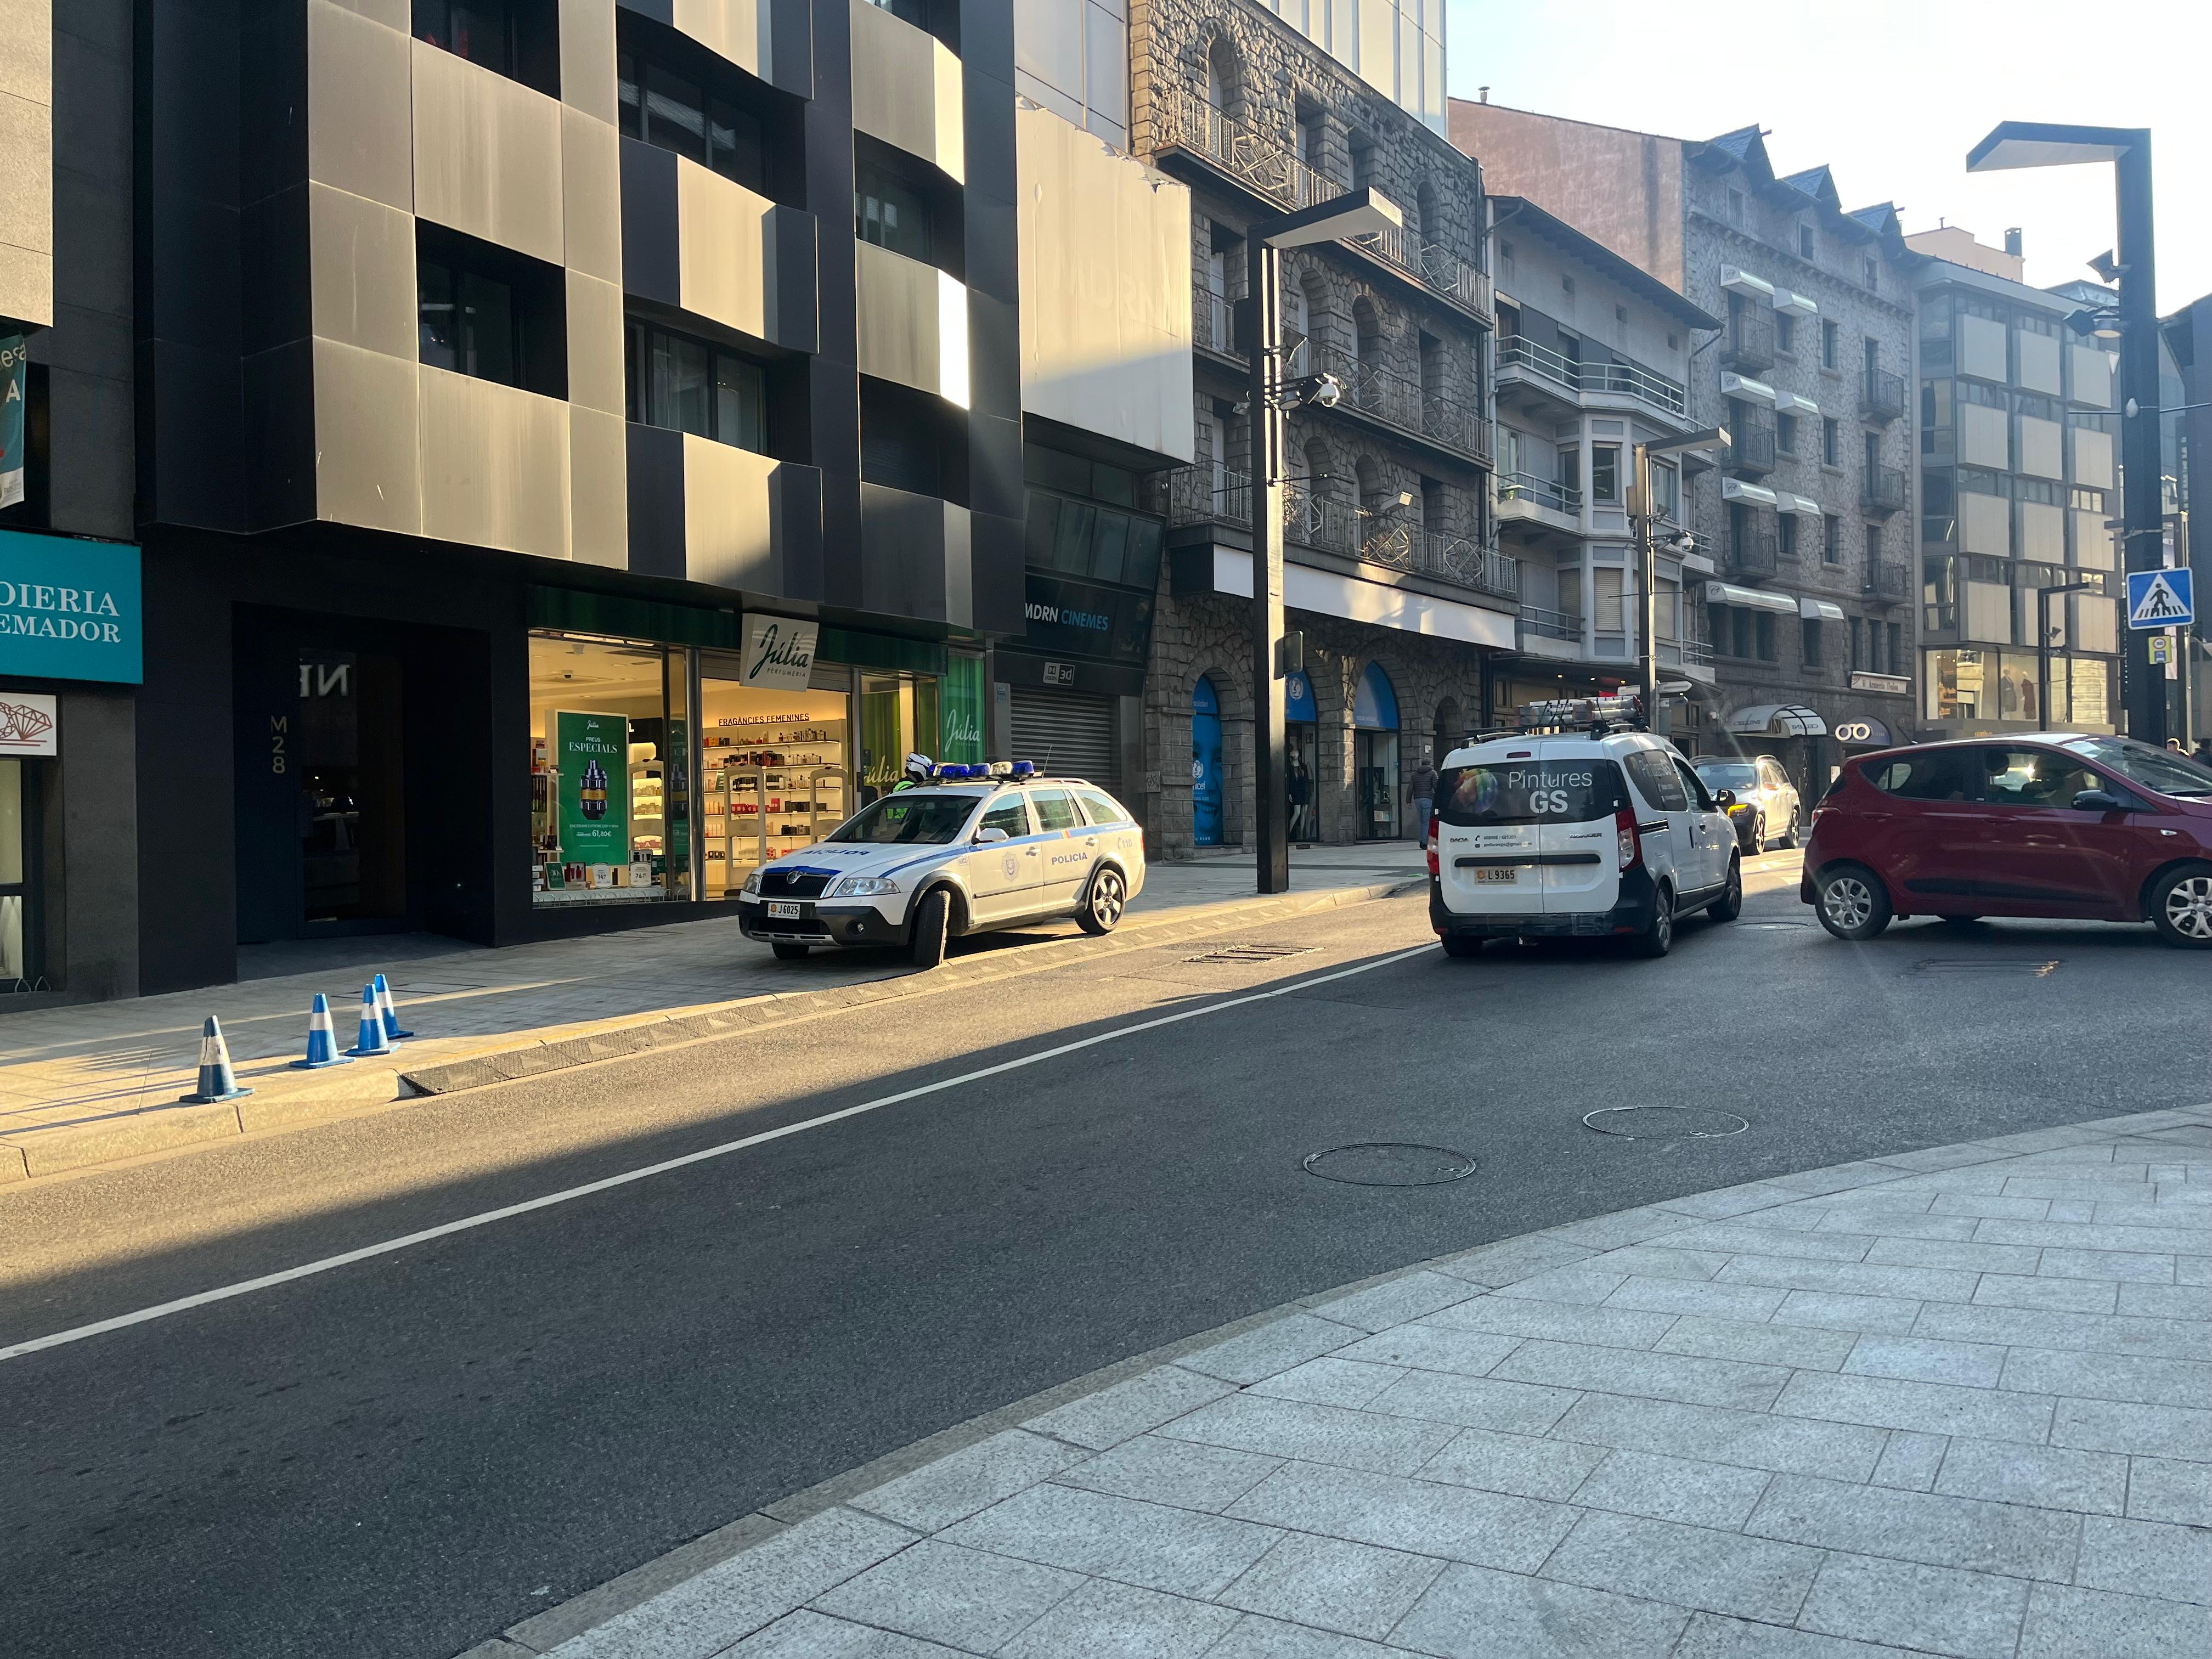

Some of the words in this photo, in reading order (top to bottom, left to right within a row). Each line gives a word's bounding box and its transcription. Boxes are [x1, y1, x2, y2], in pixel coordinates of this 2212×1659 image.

[1061, 610, 1108, 630] CINEMES
[749, 624, 809, 680] Júlia
[768, 668, 806, 678] PERFUMERIA
[719, 716, 764, 726] FRAGÀNCIES
[767, 713, 810, 723] FEMENINES
[945, 709, 980, 752] Júlia
[569, 742, 618, 754] ESPECIALS
[1509, 770, 1593, 789] Pintures
[1530, 790, 1568, 814] GS
[592, 830, 612, 838] 61,80€
[1122, 838, 1132, 848] 110
[1051, 852, 1087, 865] POLICIA
